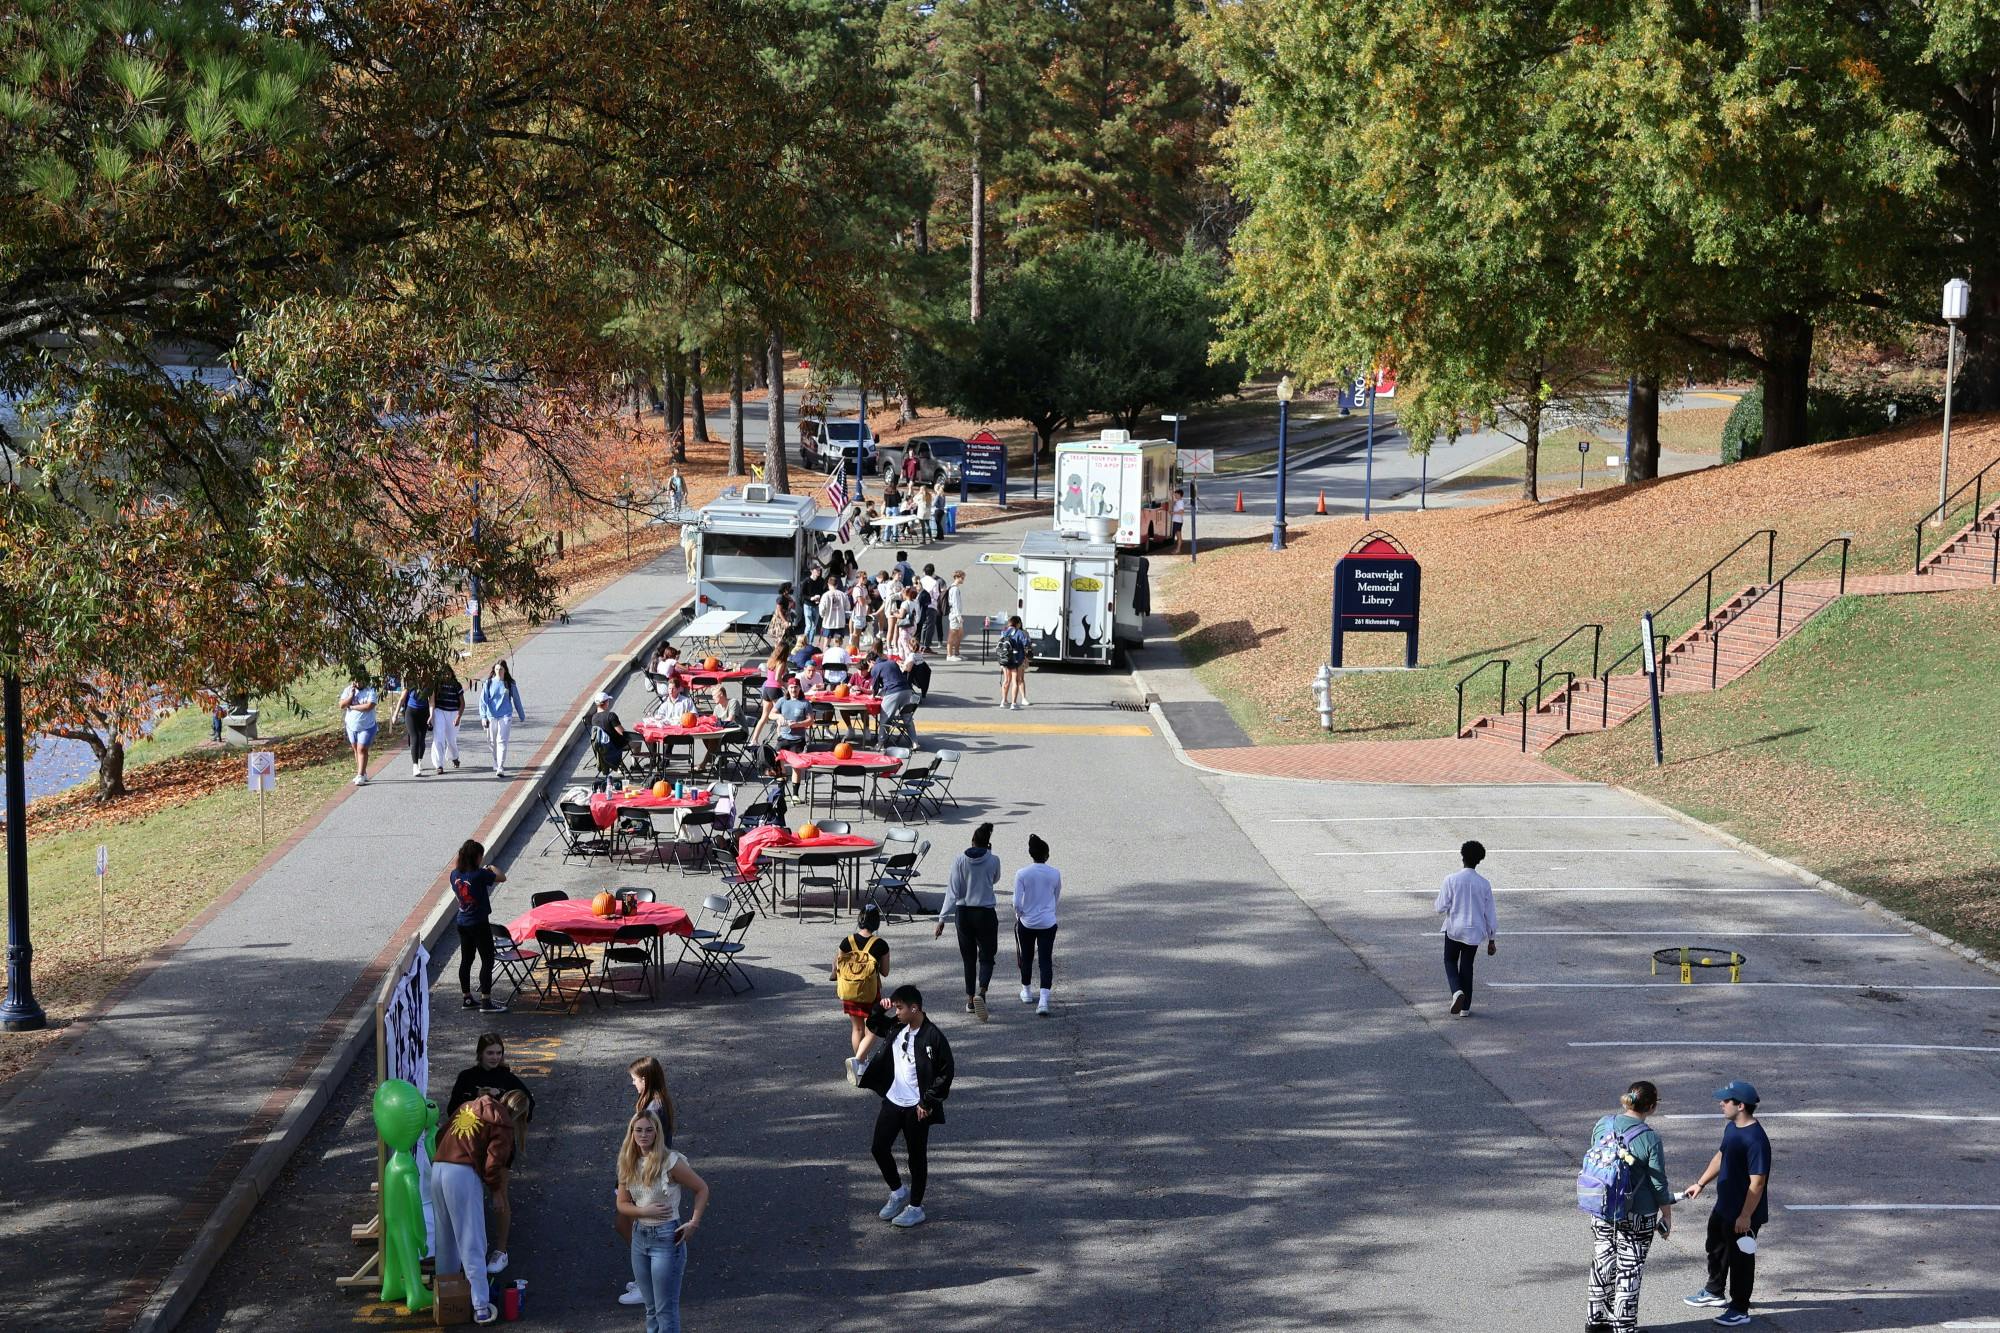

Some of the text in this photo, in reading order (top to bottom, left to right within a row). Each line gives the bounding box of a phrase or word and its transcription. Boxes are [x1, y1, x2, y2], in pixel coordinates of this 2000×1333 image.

[1355, 569, 1403, 582] Boatwright
[1357, 582, 1400, 592] Memorial
[1362, 595, 1394, 607] Library
[1390, 618, 1400, 627] Way
